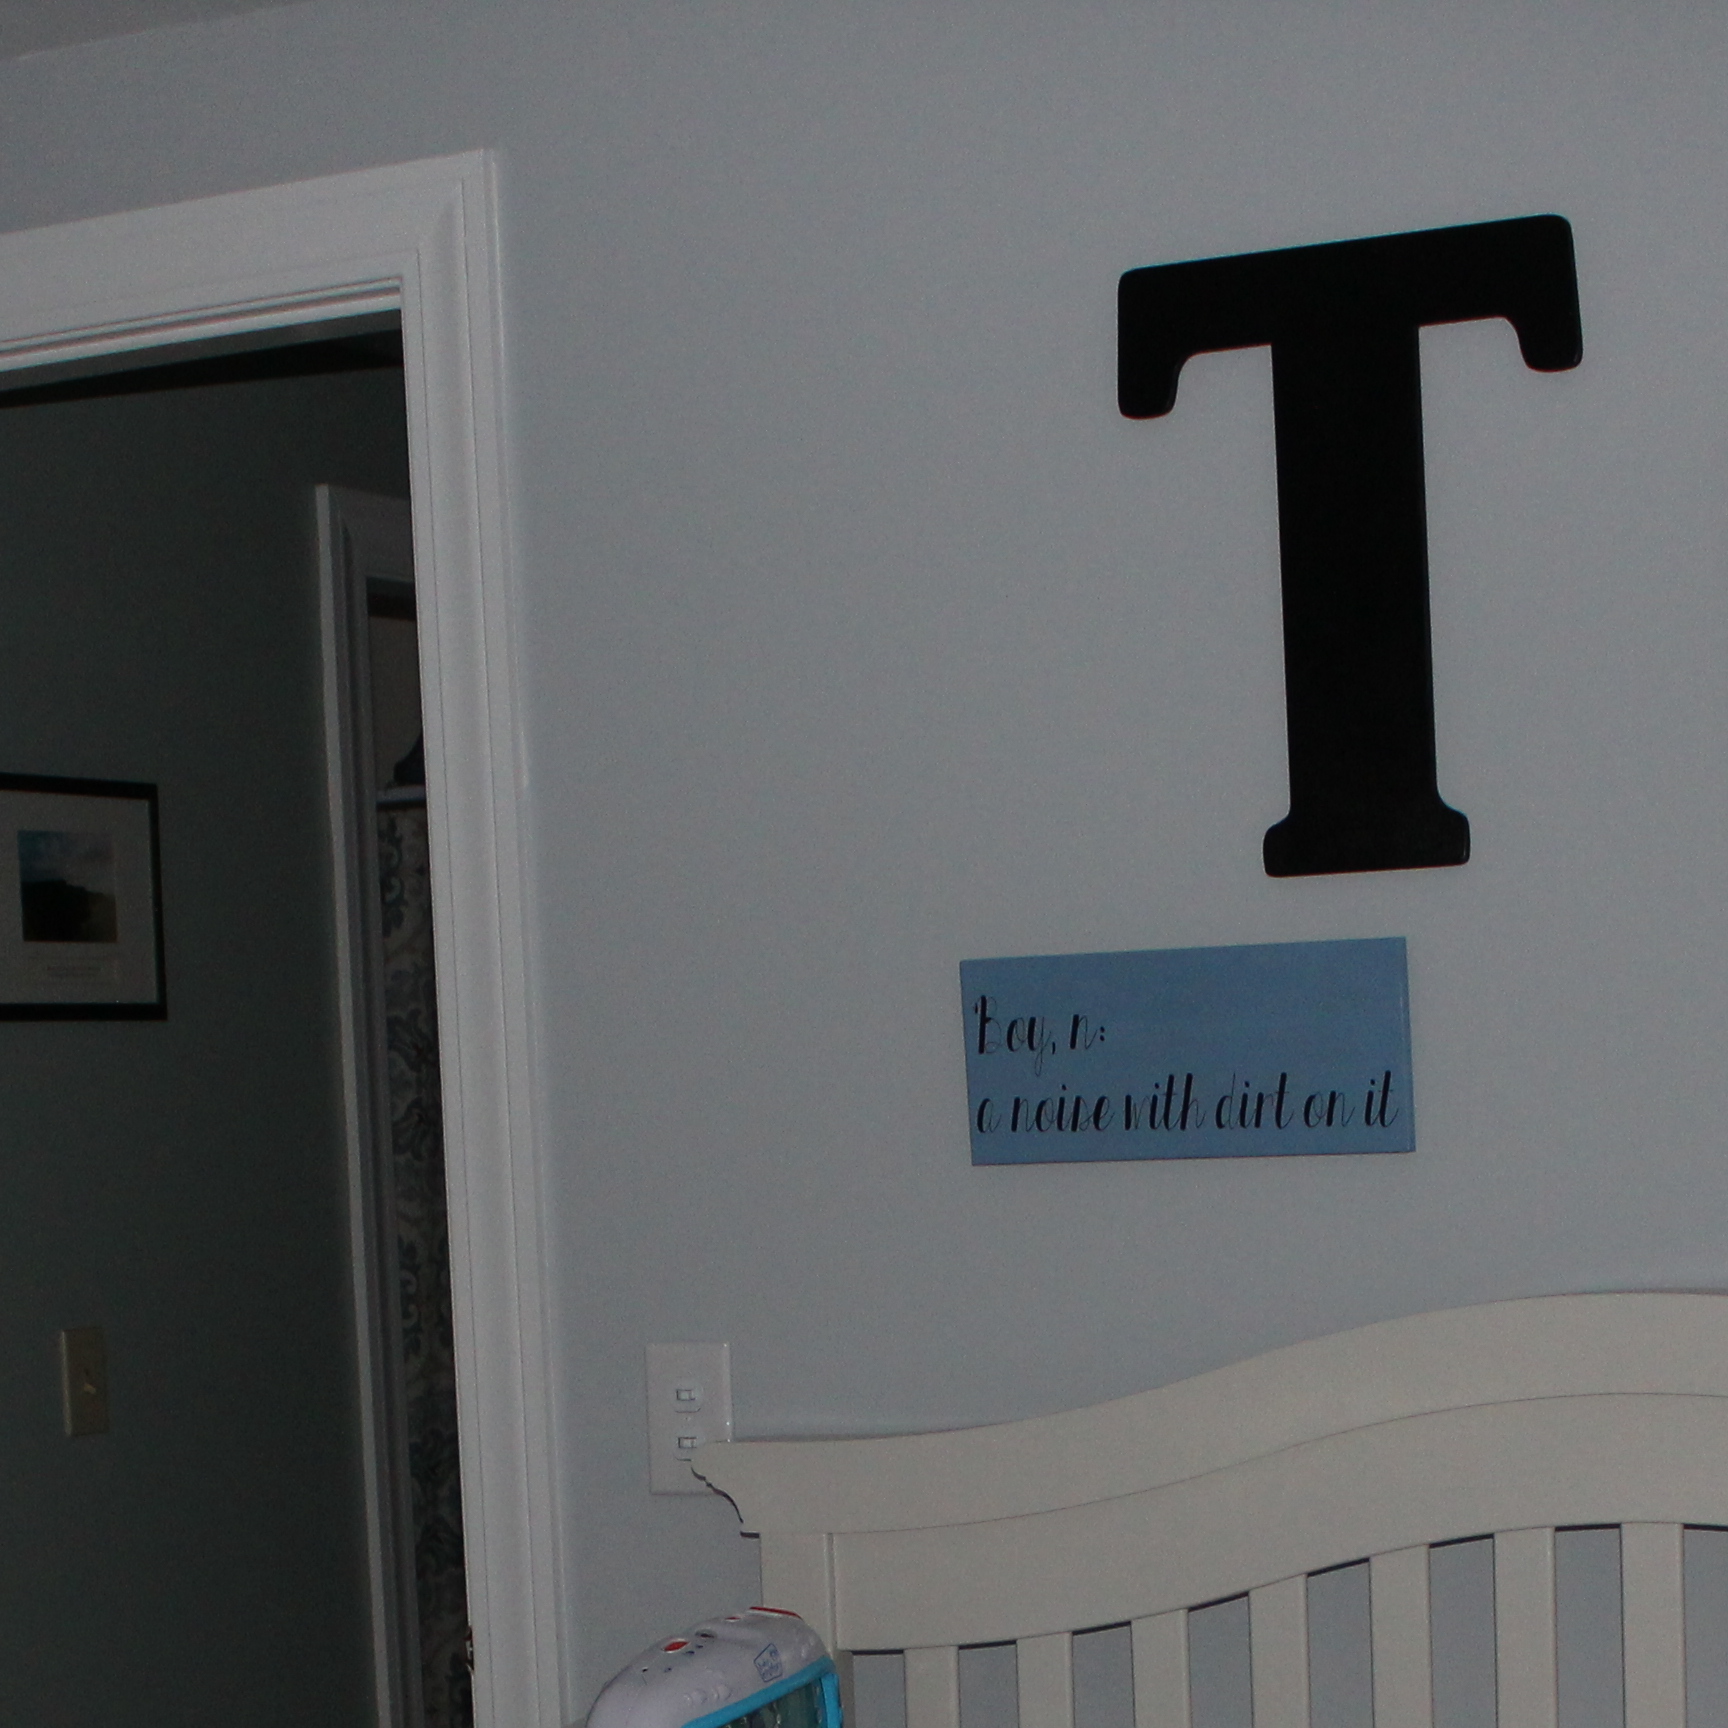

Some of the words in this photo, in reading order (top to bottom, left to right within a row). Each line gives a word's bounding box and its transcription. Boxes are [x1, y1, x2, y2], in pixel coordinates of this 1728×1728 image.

[1117, 213, 1583, 877] T
[973, 995, 1056, 1077] Boy,
[976, 1098, 1002, 1133] a
[1011, 1084, 1115, 1133] noise
[1125, 1073, 1207, 1132] with
[1215, 1071, 1295, 1130] dirt
[1304, 1090, 1355, 1128] on
[1365, 1070, 1399, 1128] it
